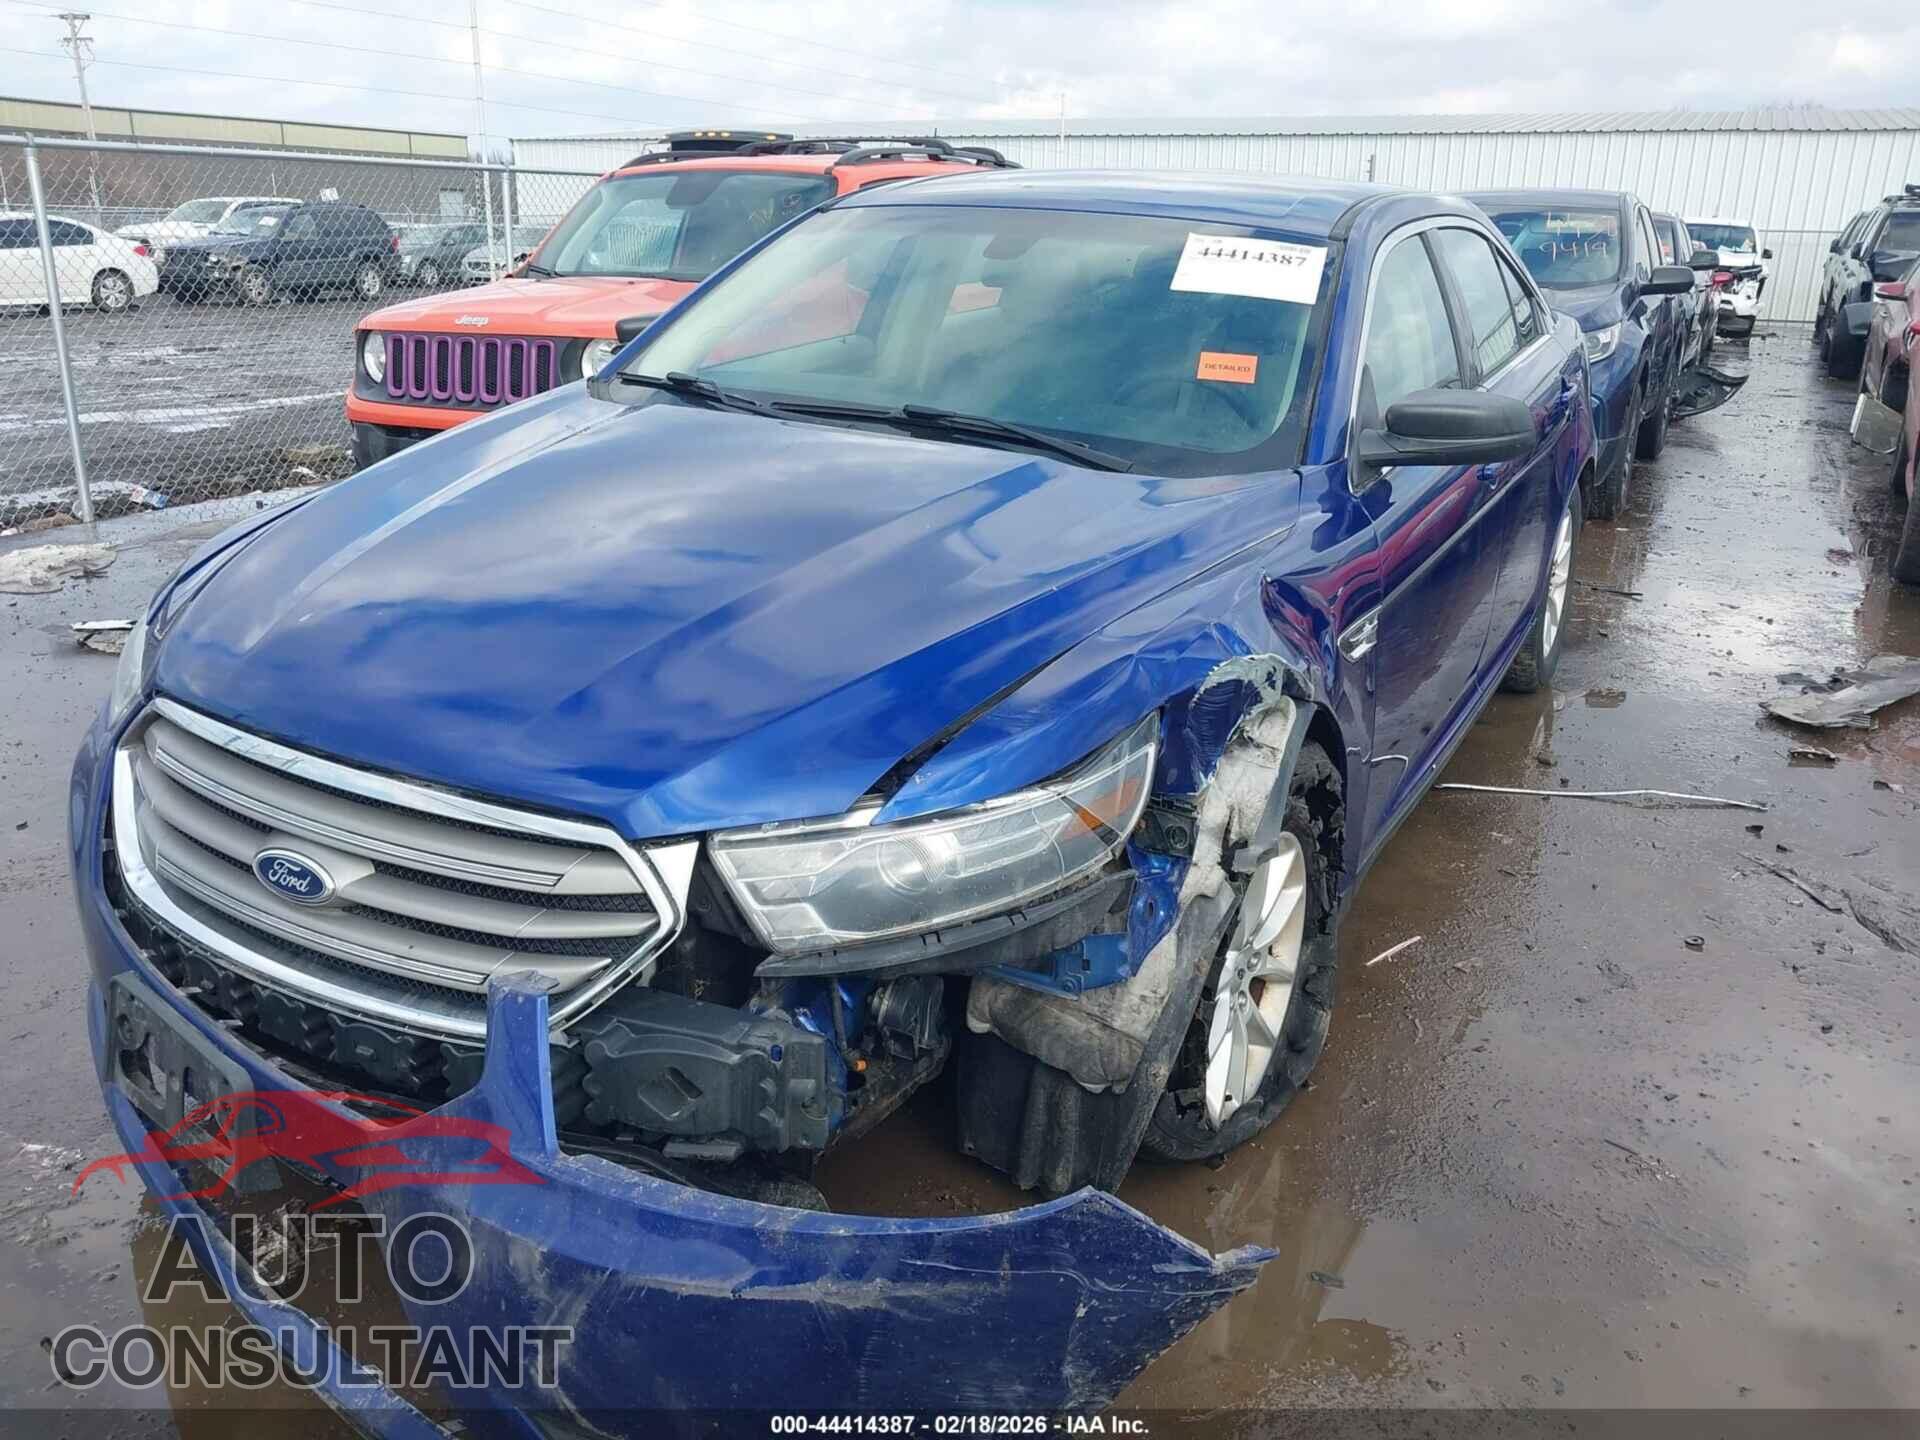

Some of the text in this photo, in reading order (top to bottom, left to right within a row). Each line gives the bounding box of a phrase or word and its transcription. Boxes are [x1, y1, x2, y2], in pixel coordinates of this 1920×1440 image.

[1198, 246, 1308, 267] 44414387
[455, 314, 489, 328] Jeep
[1204, 362, 1251, 374] DETAILED
[268, 859, 311, 893] Ford
